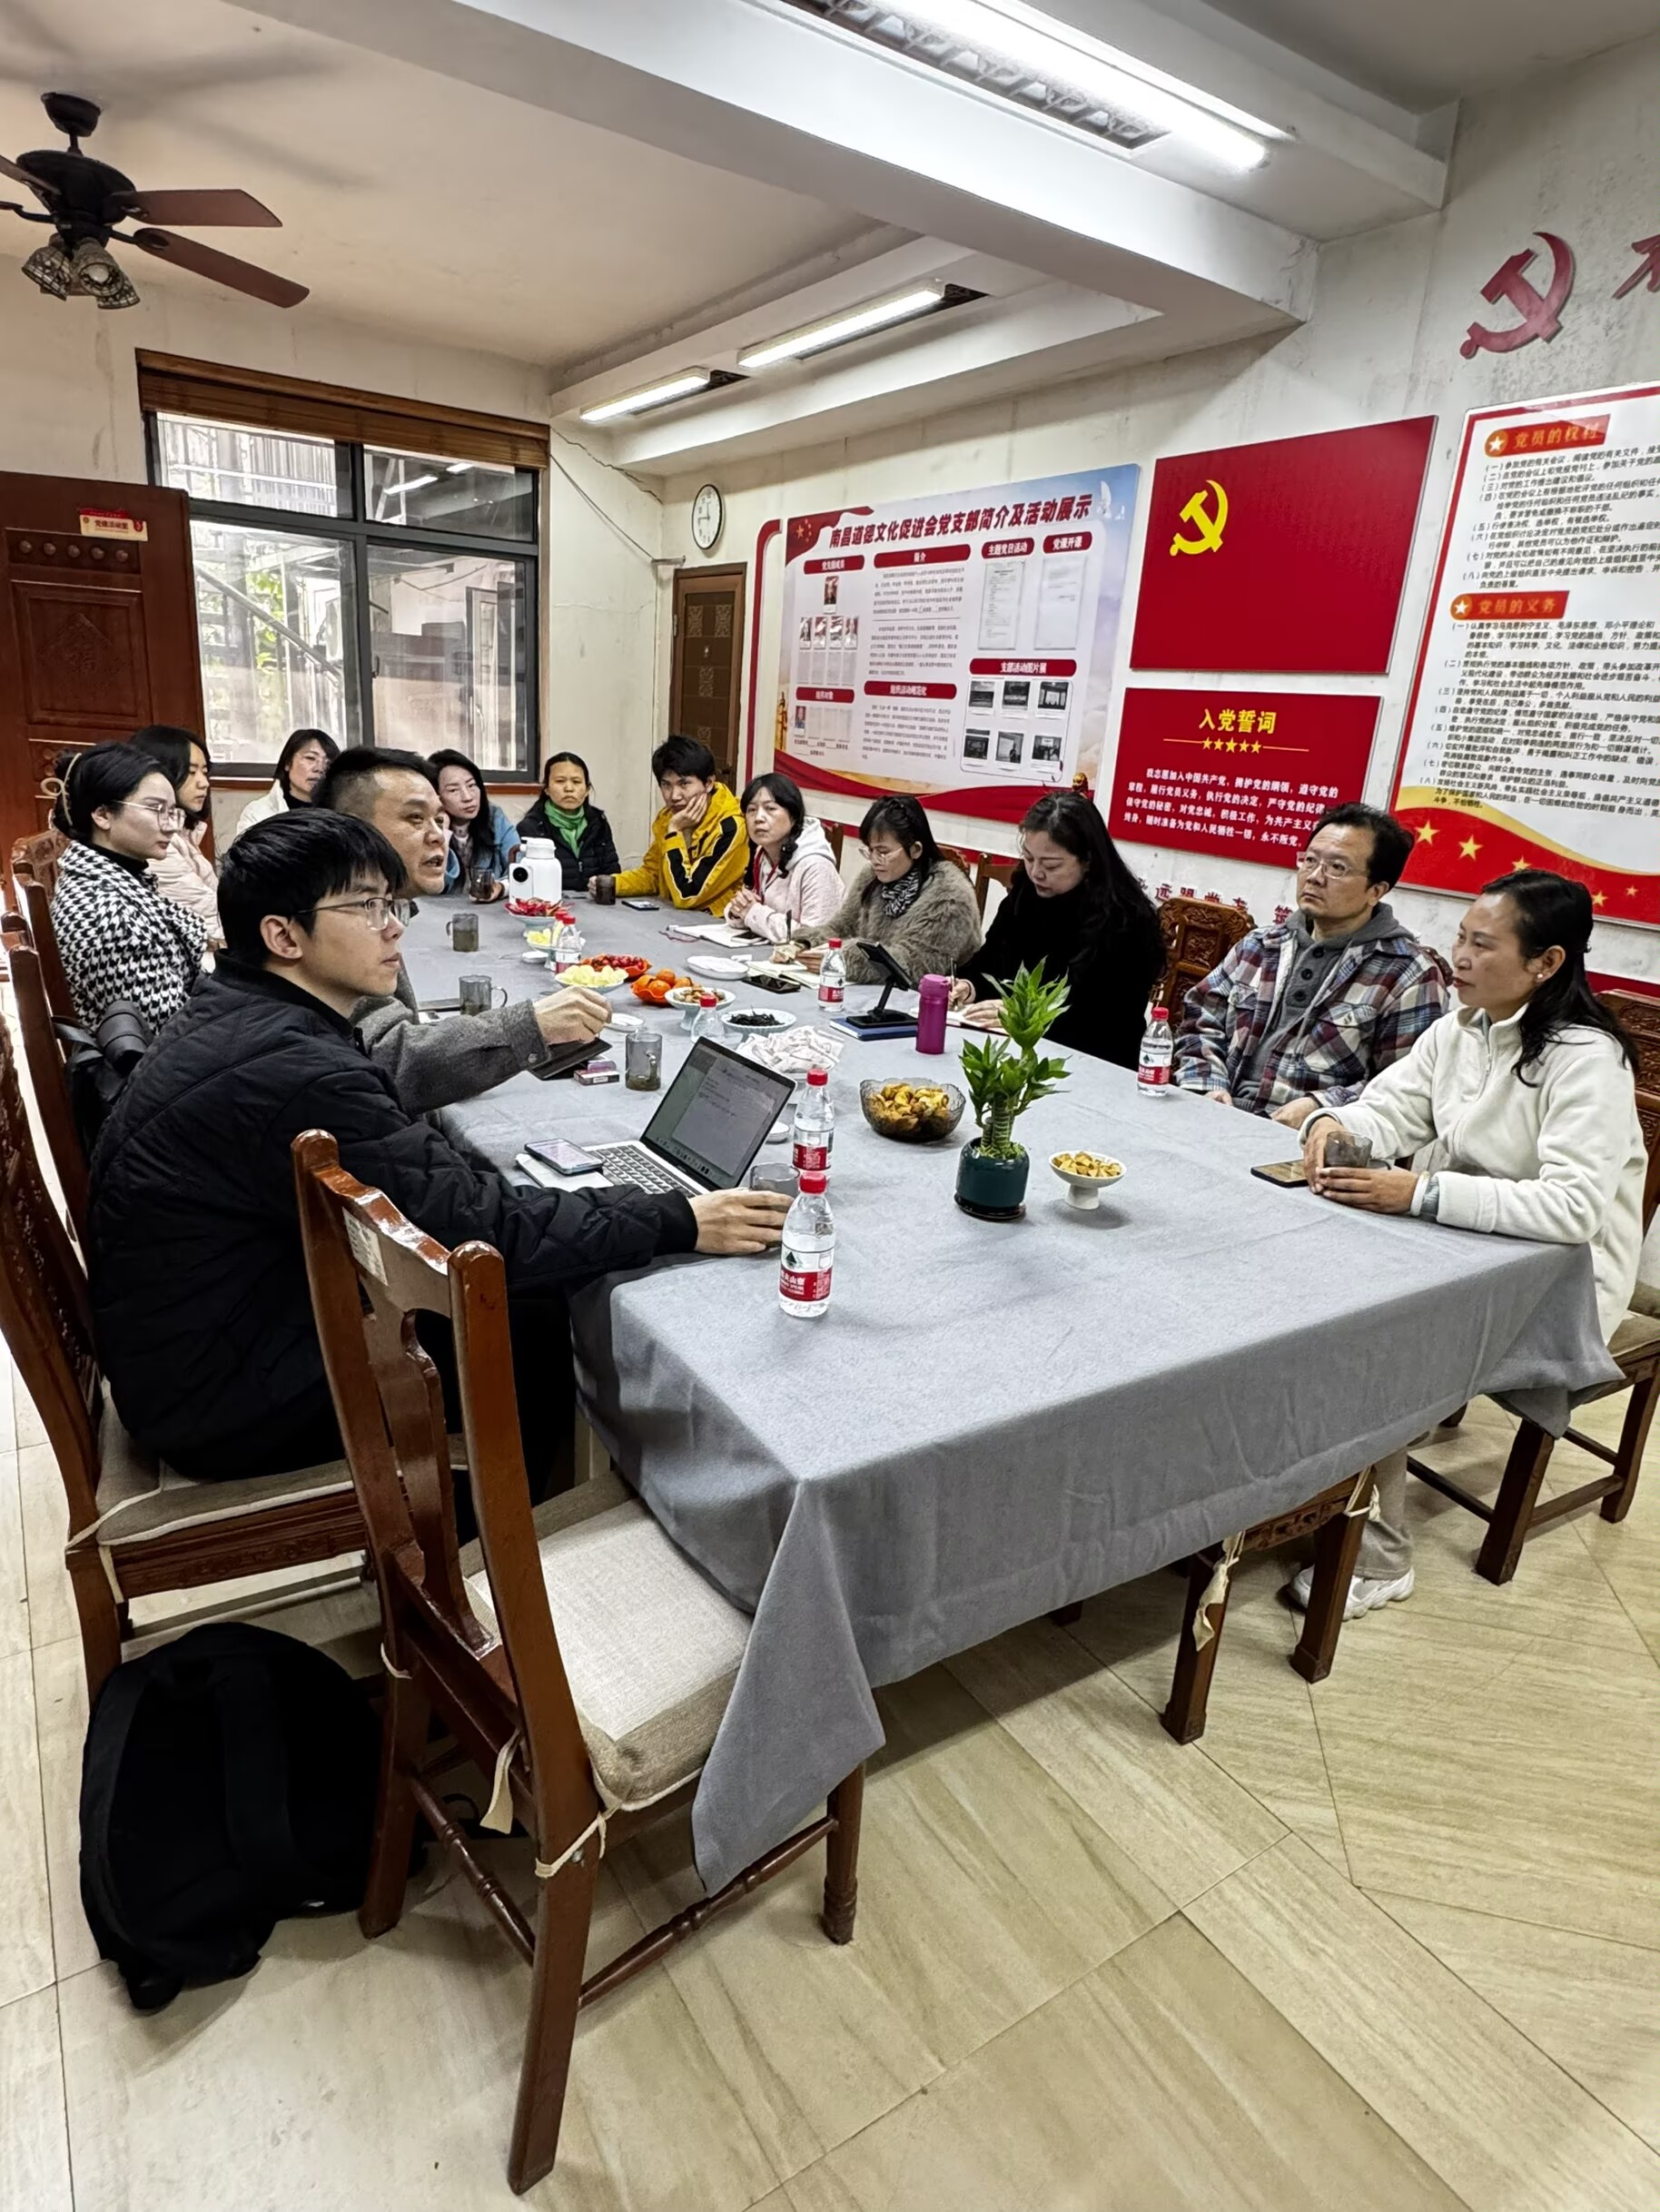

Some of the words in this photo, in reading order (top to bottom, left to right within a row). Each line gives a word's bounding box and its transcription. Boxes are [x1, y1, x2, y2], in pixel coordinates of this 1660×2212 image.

[1513, 422, 1600, 449] 党员的权利
[829, 494, 1092, 548] 南昌道德文化促进会党支部简介及活动展示
[988, 541, 1028, 556] 主题党日活动
[1477, 597, 1556, 616] 党员的义务
[1198, 708, 1277, 734] 入党誓词
[1146, 768, 1339, 798] 我志愿加入中国共产党，拥护党的纲领，遵守党的
[1123, 812, 1302, 847] 终身，随时准备为党和人民牺牲一切，永不叛党。
